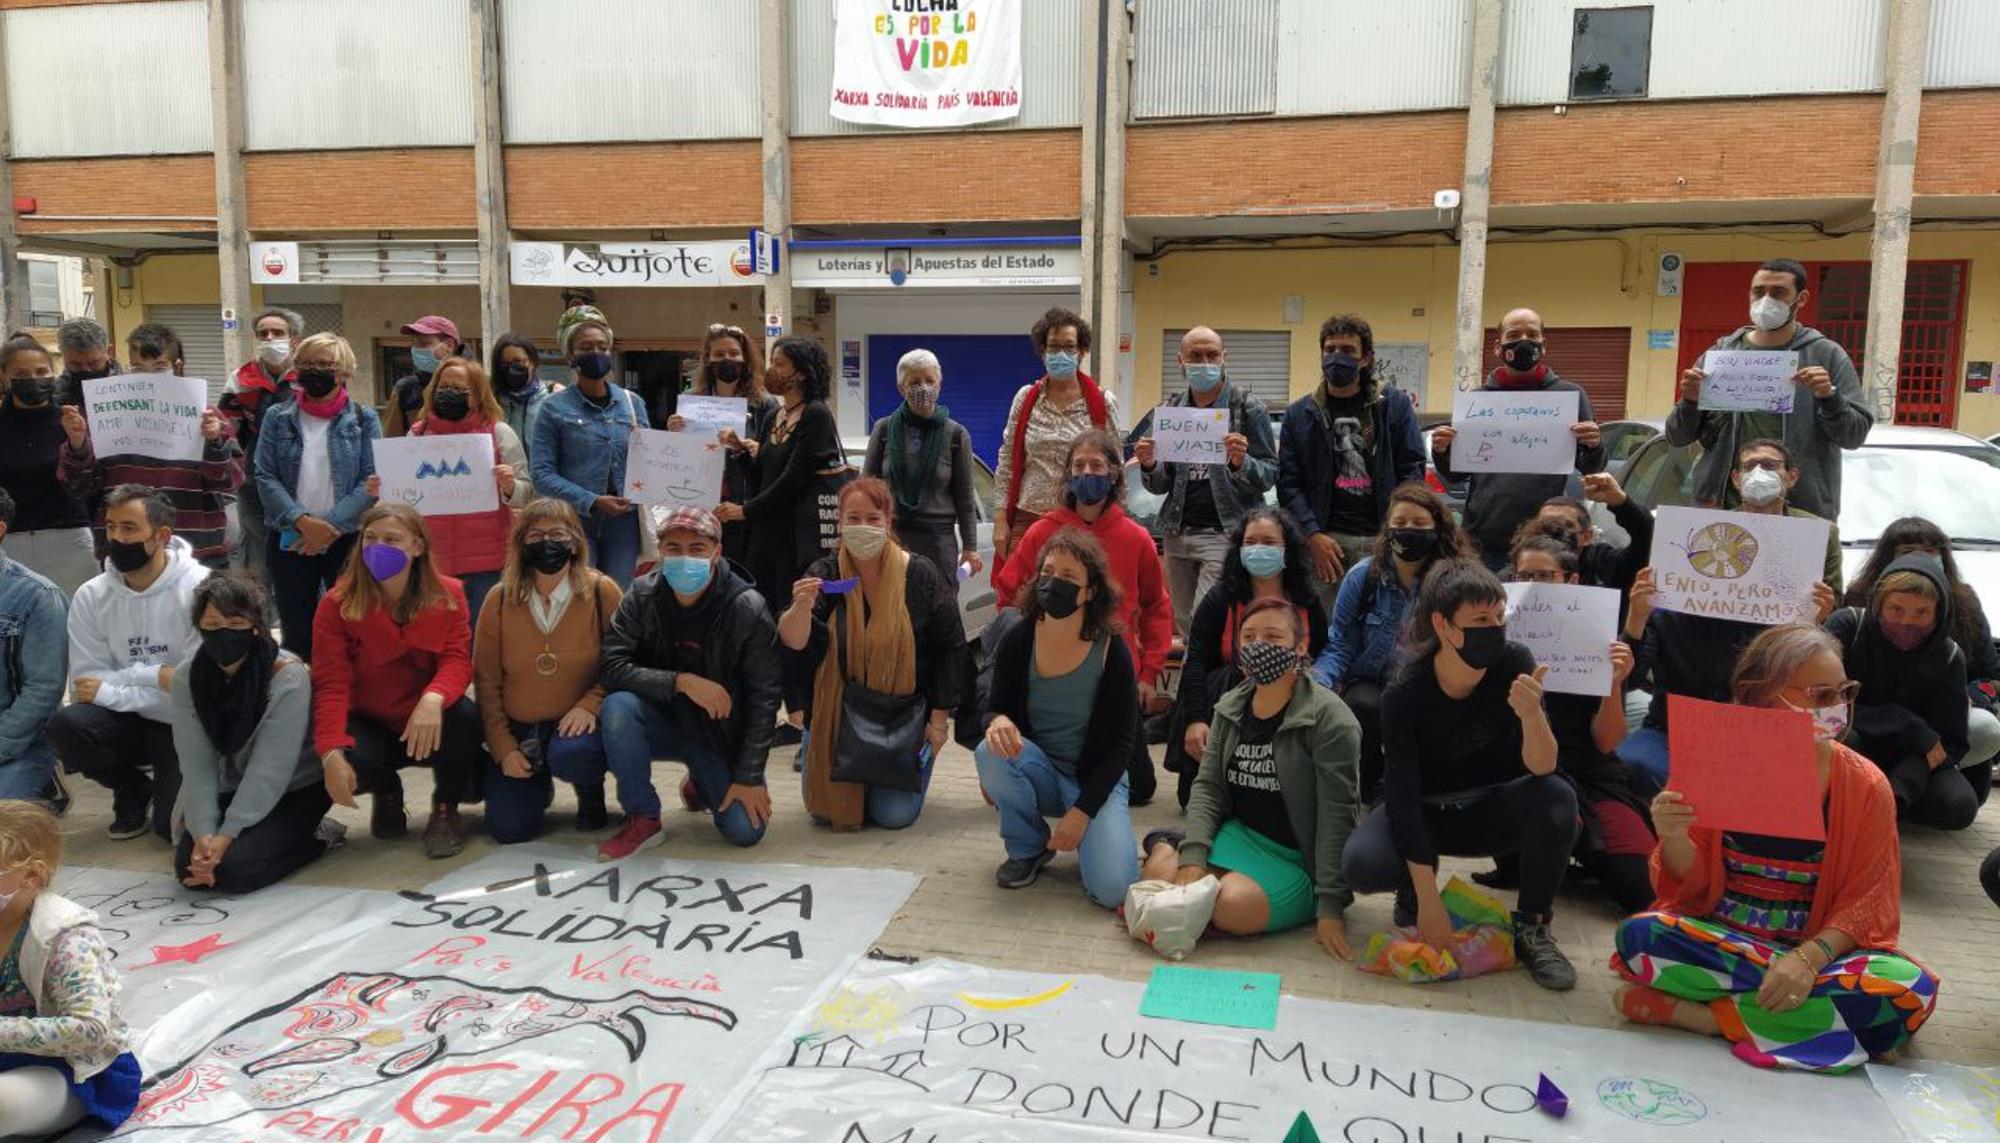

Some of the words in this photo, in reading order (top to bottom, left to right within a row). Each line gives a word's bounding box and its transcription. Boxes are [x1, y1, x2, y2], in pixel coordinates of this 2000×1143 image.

[908, 13, 942, 35] POR
[953, 12, 977, 33] LA
[834, 88, 870, 106] XARXA
[818, 256, 872, 271] Loterías
[875, 261, 883, 274] y
[914, 256, 978, 273] Apuestas
[981, 254, 1002, 269] del
[1006, 253, 1055, 269] Estado
[93, 398, 155, 415] DEFENSANT
[174, 404, 198, 418] VIDA
[1160, 418, 1209, 433] BUEN
[1174, 439, 1223, 453] VIAJE
[1727, 583, 1773, 600] PERO
[910, 1003, 1037, 1055] POR
[1100, 1032, 1185, 1067] UN
[1248, 1037, 1541, 1114] MUNDO
[394, 1061, 686, 1143] GIRA
[962, 1067, 1261, 1142] DONDE
